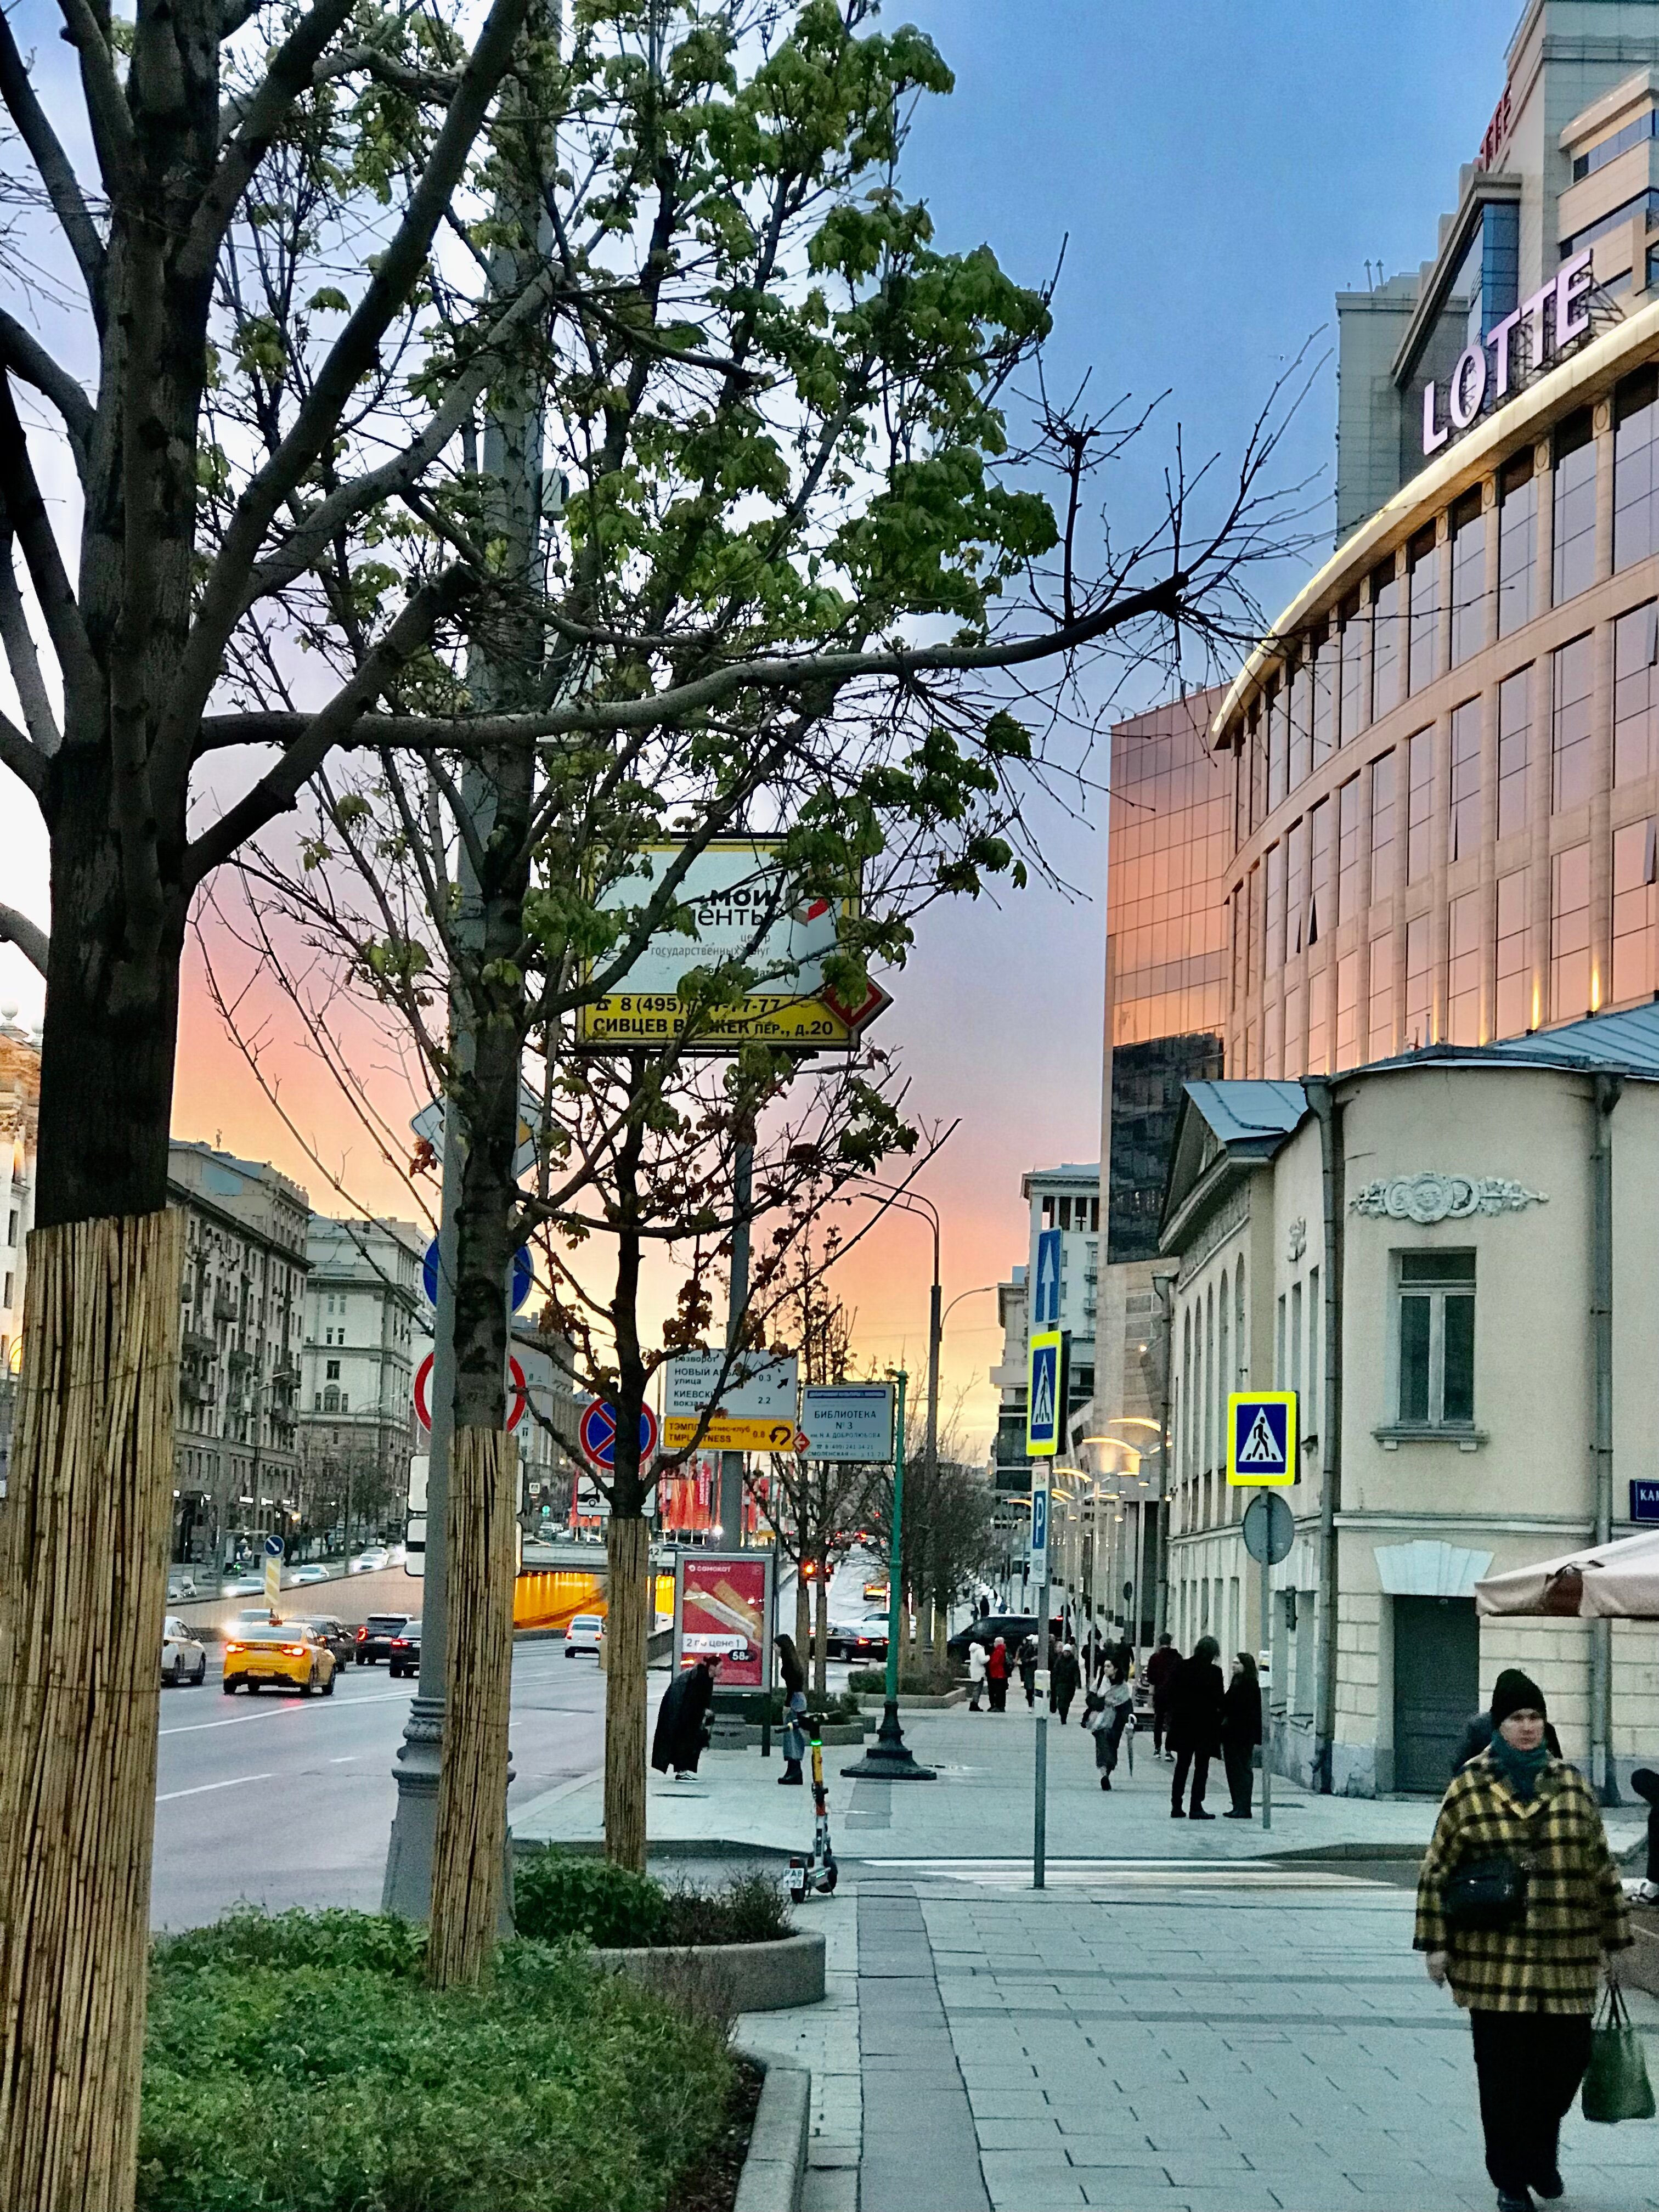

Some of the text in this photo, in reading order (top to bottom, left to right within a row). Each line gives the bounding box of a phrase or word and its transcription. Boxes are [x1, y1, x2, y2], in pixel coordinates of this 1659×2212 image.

[1423, 248, 1594, 455] LOTTE
[651, 946, 739, 958] государственных
[620, 997, 631, 1011] 8
[636, 997, 684, 1014] (495)
[594, 1018, 668, 1035] СИВЦЕВ
[674, 1019, 749, 1034] ВЖЕК
[675, 1367, 710, 1376] НОВЫЙ
[674, 1390, 723, 1398] КИЕВСК
[758, 1396, 771, 1404] 2.2
[814, 1410, 876, 1419] БИБЛИОТЕКА
[687, 1638, 692, 1647] 2
